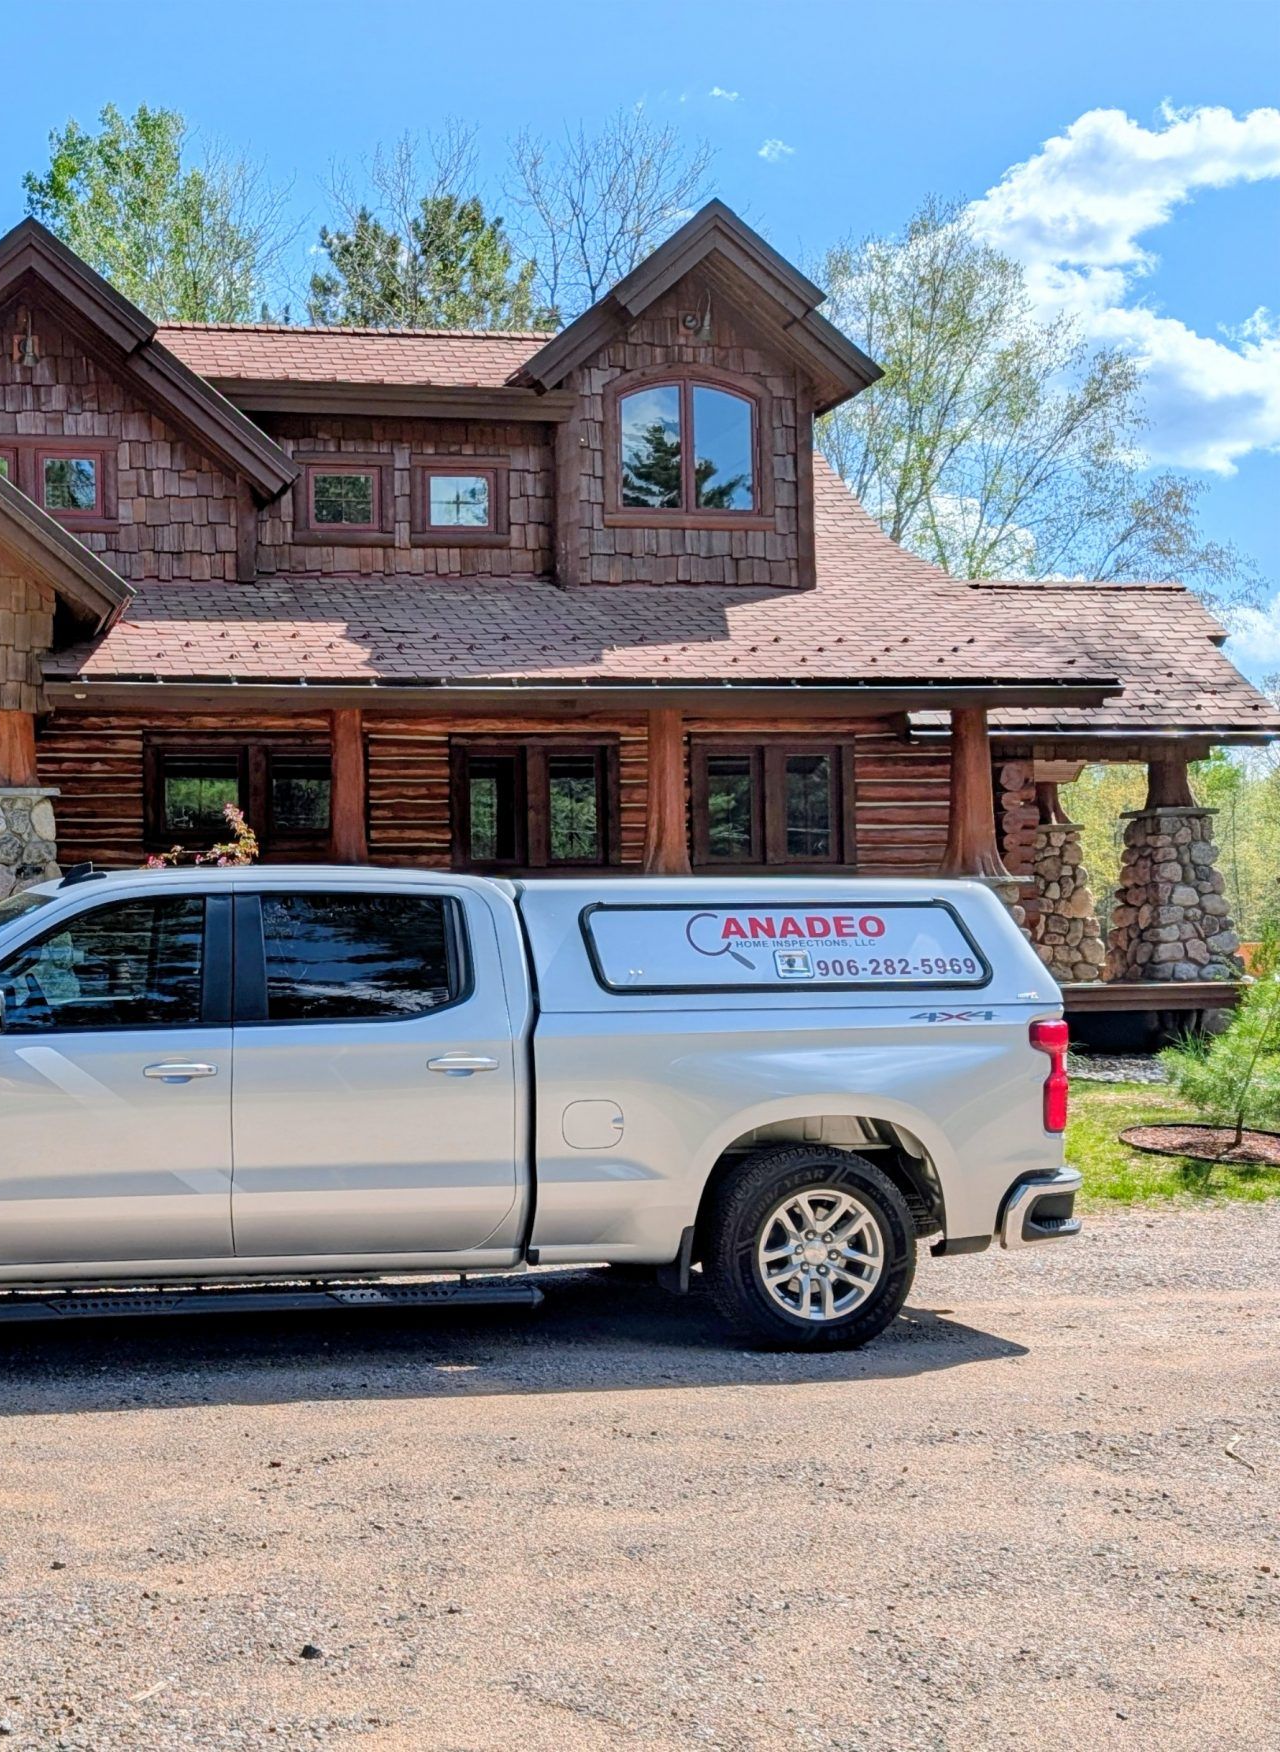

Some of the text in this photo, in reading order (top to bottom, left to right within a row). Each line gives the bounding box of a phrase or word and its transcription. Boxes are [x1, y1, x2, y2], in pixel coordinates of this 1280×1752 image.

[736, 938, 876, 949] HOME INSPECTIONS, LLC
[816, 957, 976, 977] 906-282-5969
